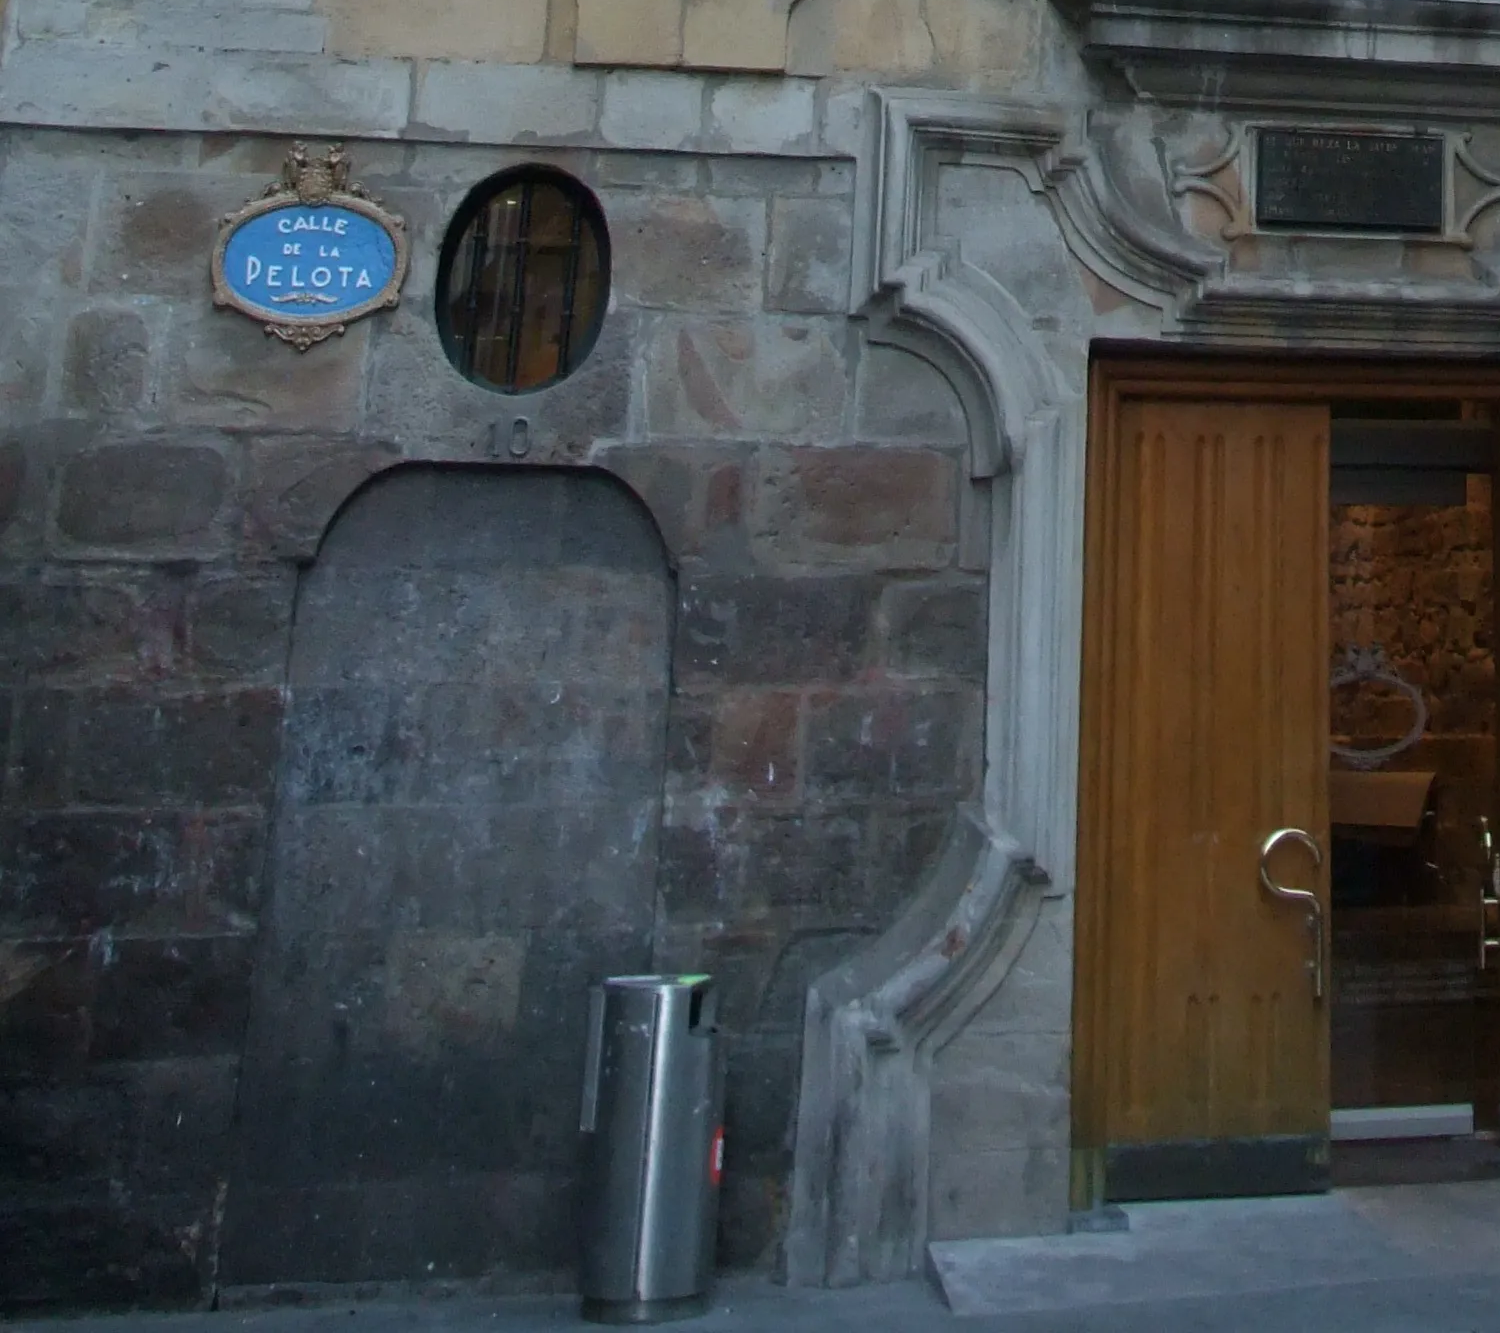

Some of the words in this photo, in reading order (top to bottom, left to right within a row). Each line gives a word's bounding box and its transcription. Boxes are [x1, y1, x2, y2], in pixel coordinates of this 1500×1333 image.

[278, 215, 349, 235] CALLE
[283, 243, 302, 255] DE
[319, 245, 341, 257] LA
[246, 255, 372, 288] PELOTA
